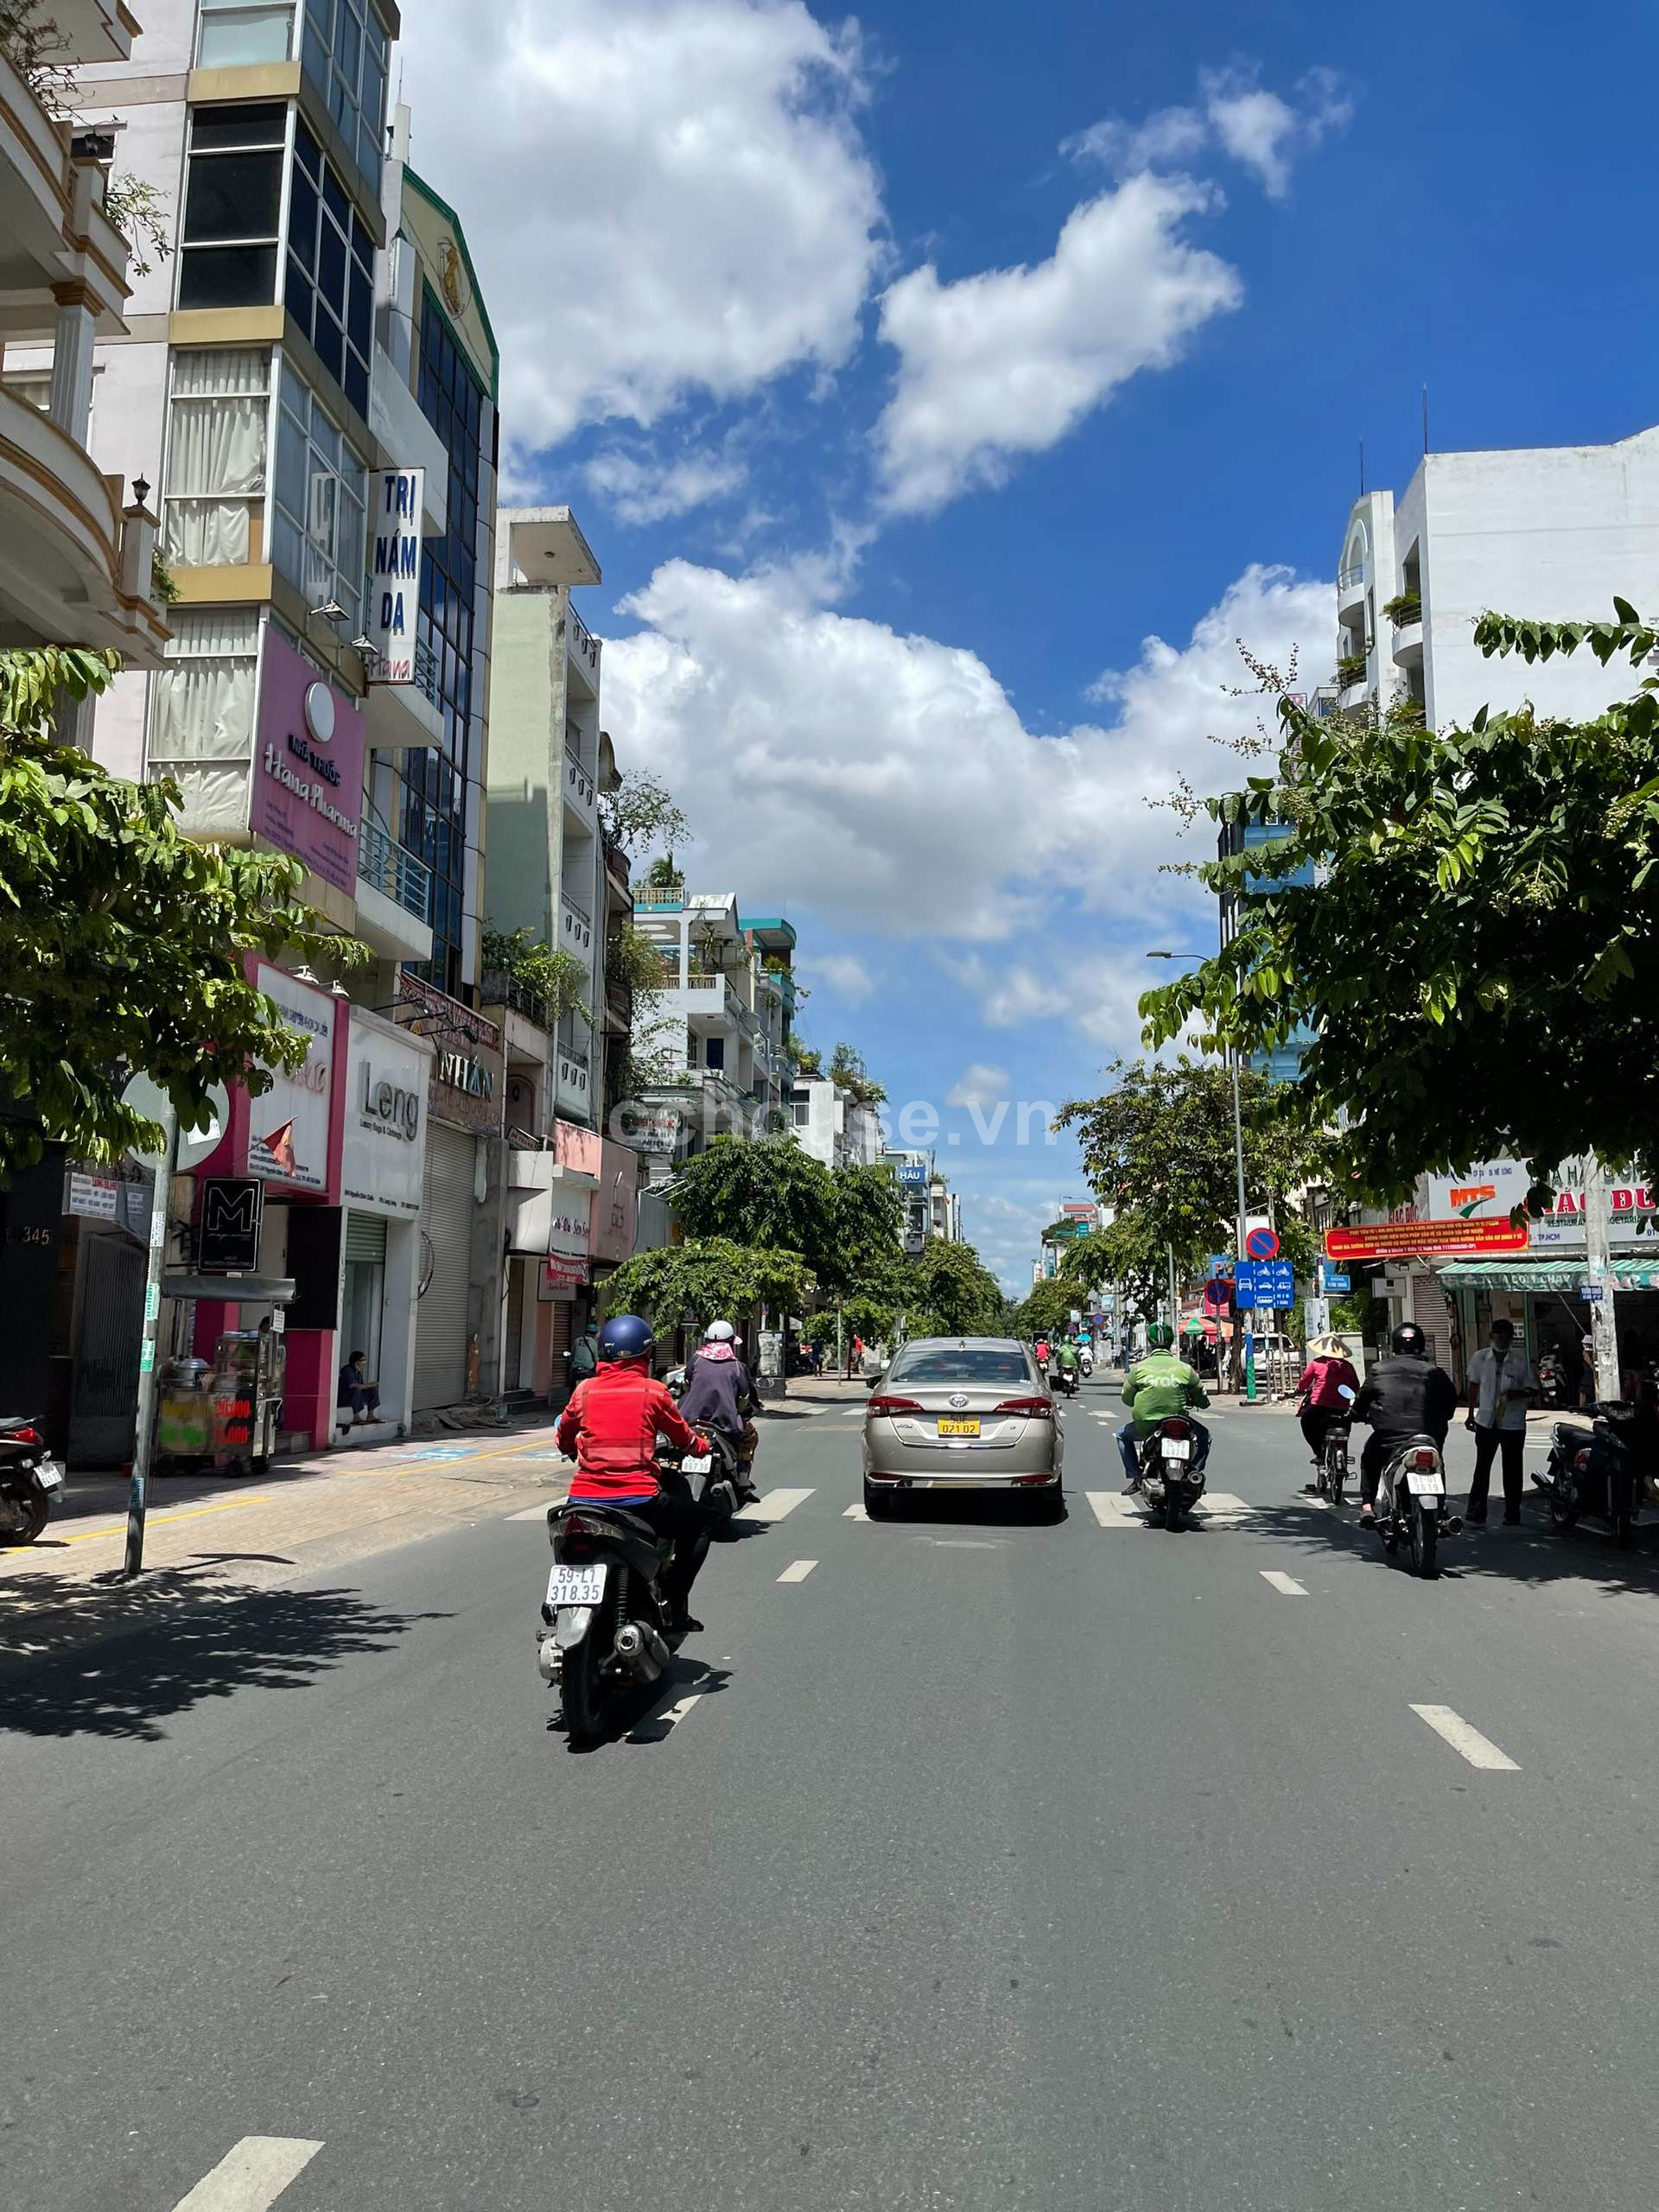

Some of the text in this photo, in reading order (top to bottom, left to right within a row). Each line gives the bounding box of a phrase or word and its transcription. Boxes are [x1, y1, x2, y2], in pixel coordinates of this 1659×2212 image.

[385, 474, 416, 523] TRỊ
[375, 528, 417, 575] NÁM
[380, 591, 405, 630] DA
[309, 783, 359, 839] Pharma
[358, 1060, 420, 1142] Leng
[207, 1186, 255, 1232] M
[1450, 1185, 1496, 1208] MTS
[1146, 1373, 1179, 1388] Grab
[942, 1424, 976, 1434] 021.02
[550, 1585, 600, 1601] 318.35
